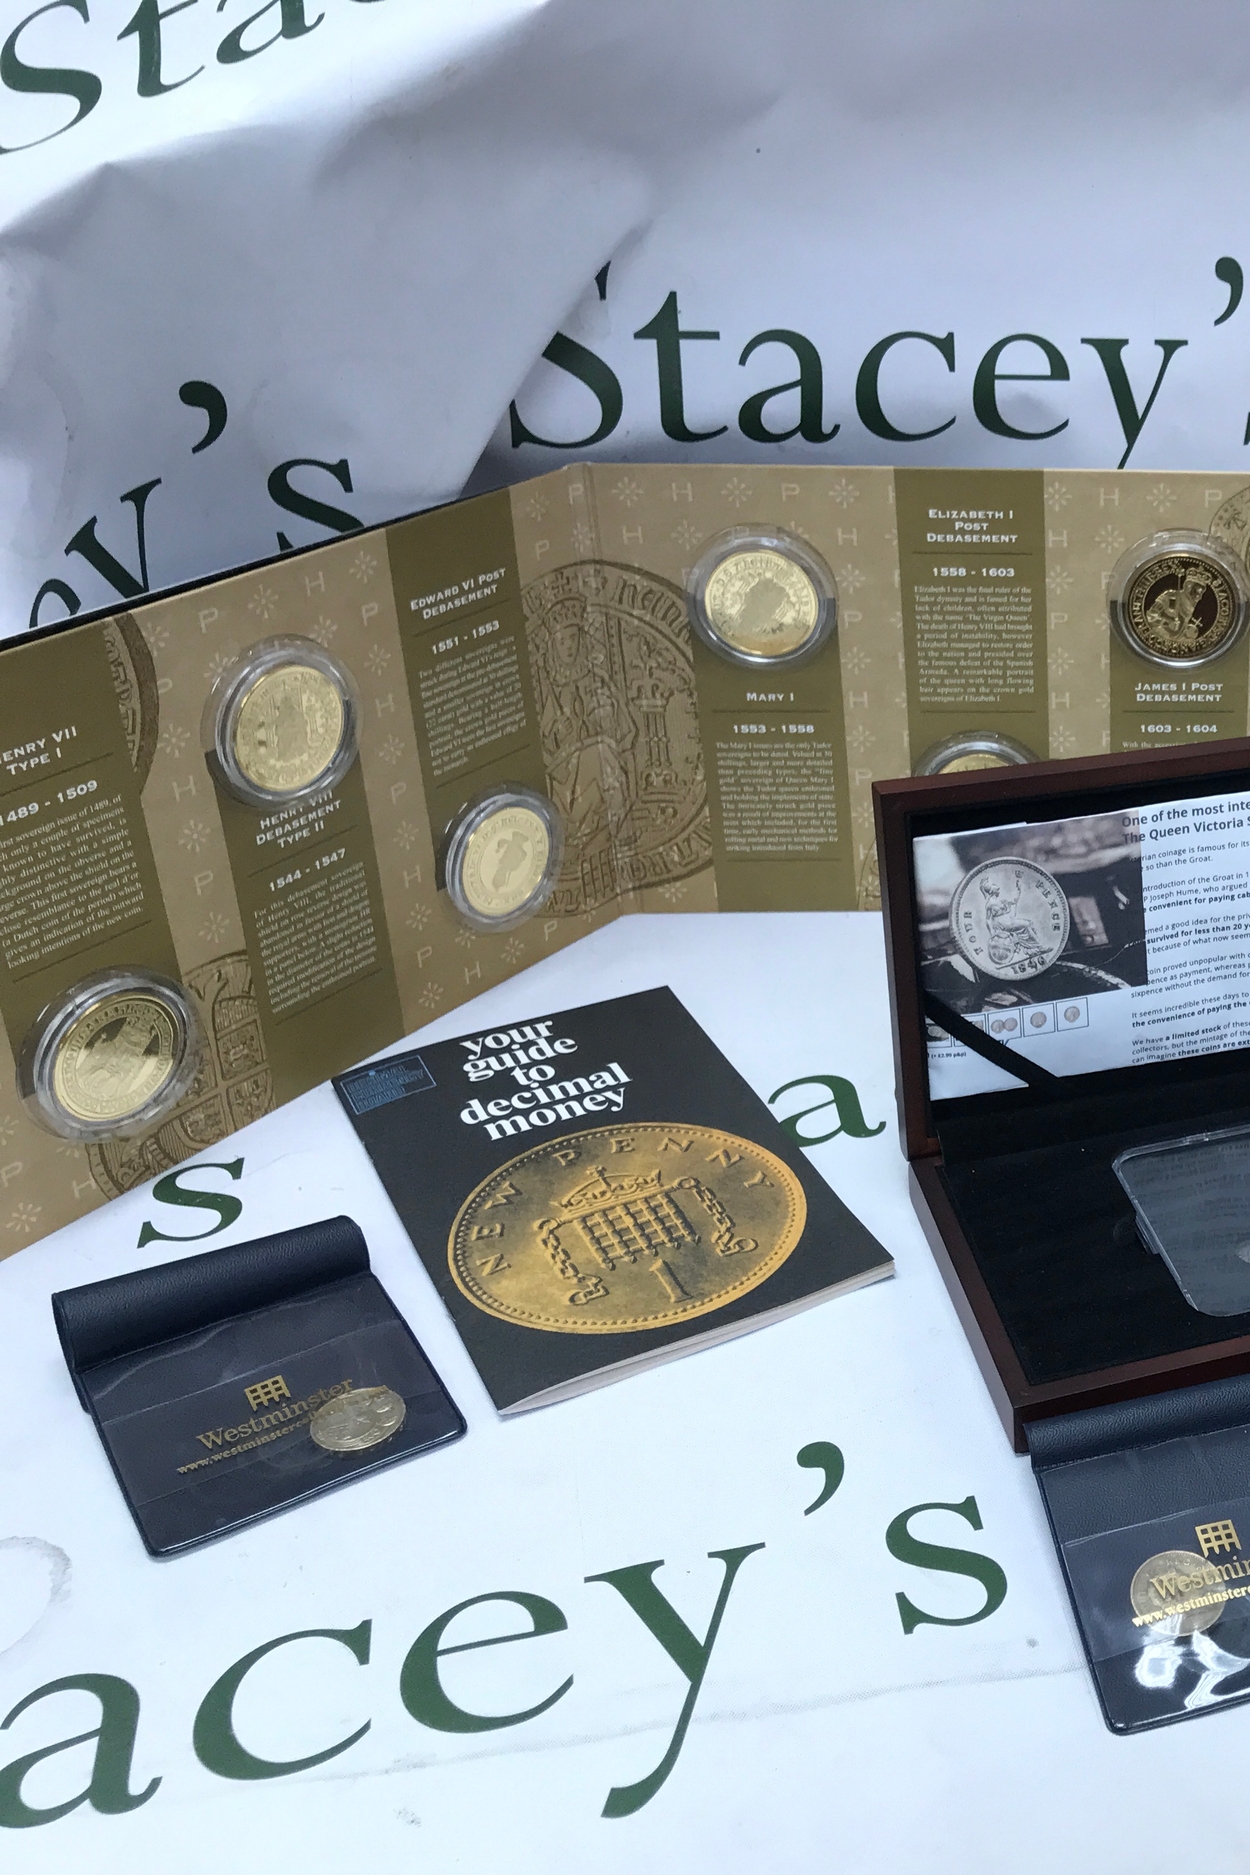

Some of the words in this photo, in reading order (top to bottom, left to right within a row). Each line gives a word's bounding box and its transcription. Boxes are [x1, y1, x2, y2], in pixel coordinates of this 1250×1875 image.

[928, 508, 1004, 519] ELIZABETH
[926, 532, 1019, 543] DEBASEMENT
[954, 521, 989, 531] POST
[932, 567, 967, 577] 1558
[981, 567, 1016, 577] 1603
[410, 585, 459, 611] EDWARD
[462, 578, 475, 591] VI
[478, 568, 506, 585] POST
[422, 584, 498, 620] DEBASEMENT
[432, 636, 459, 655] 1551
[472, 620, 500, 639] 1553
[746, 692, 784, 702] MARY
[1134, 682, 1178, 691] JAMES
[1191, 682, 1224, 691] POST
[1136, 693, 1222, 702] DEBASEMENT
[733, 724, 767, 734] 1553
[781, 724, 815, 734] 1558
[1140, 724, 1172, 733] 1603
[1186, 724, 1218, 733] 1604
[0, 738, 46, 764] ENRY
[52, 726, 77, 743] VII
[6, 753, 51, 775] TYPE
[57, 780, 98, 803] 1509
[256, 800, 341, 846] DEBASEMENT
[1122, 816, 1147, 827] One
[1151, 811, 1163, 822] of
[1167, 809, 1188, 820] the
[1192, 804, 1224, 816] most
[277, 828, 311, 848] TYPE
[1122, 832, 1145, 844] The
[1150, 825, 1189, 841] Queen
[1194, 818, 1243, 832] Victoria
[270, 870, 302, 891] 1544
[315, 848, 346, 870] 1547
[1149, 896, 1192, 912] convenient
[1195, 896, 1206, 904] for
[1208, 892, 1235, 904] paying
[1238, 891, 1250, 899] cab
[1146, 932, 1179, 944] survived
[1195, 928, 1210, 936] less
[1212, 924, 1230, 933] than
[1132, 1020, 1145, 1028] the
[1148, 1012, 1195, 1026] convenience
[1207, 1003, 1232, 1015] paying
[459, 1020, 554, 1060] your
[463, 1037, 578, 1082] guide
[510, 1064, 556, 1086] to
[460, 1062, 633, 1125] decimal
[483, 1087, 626, 1141] money
[196, 1379, 353, 1451] Westminster
